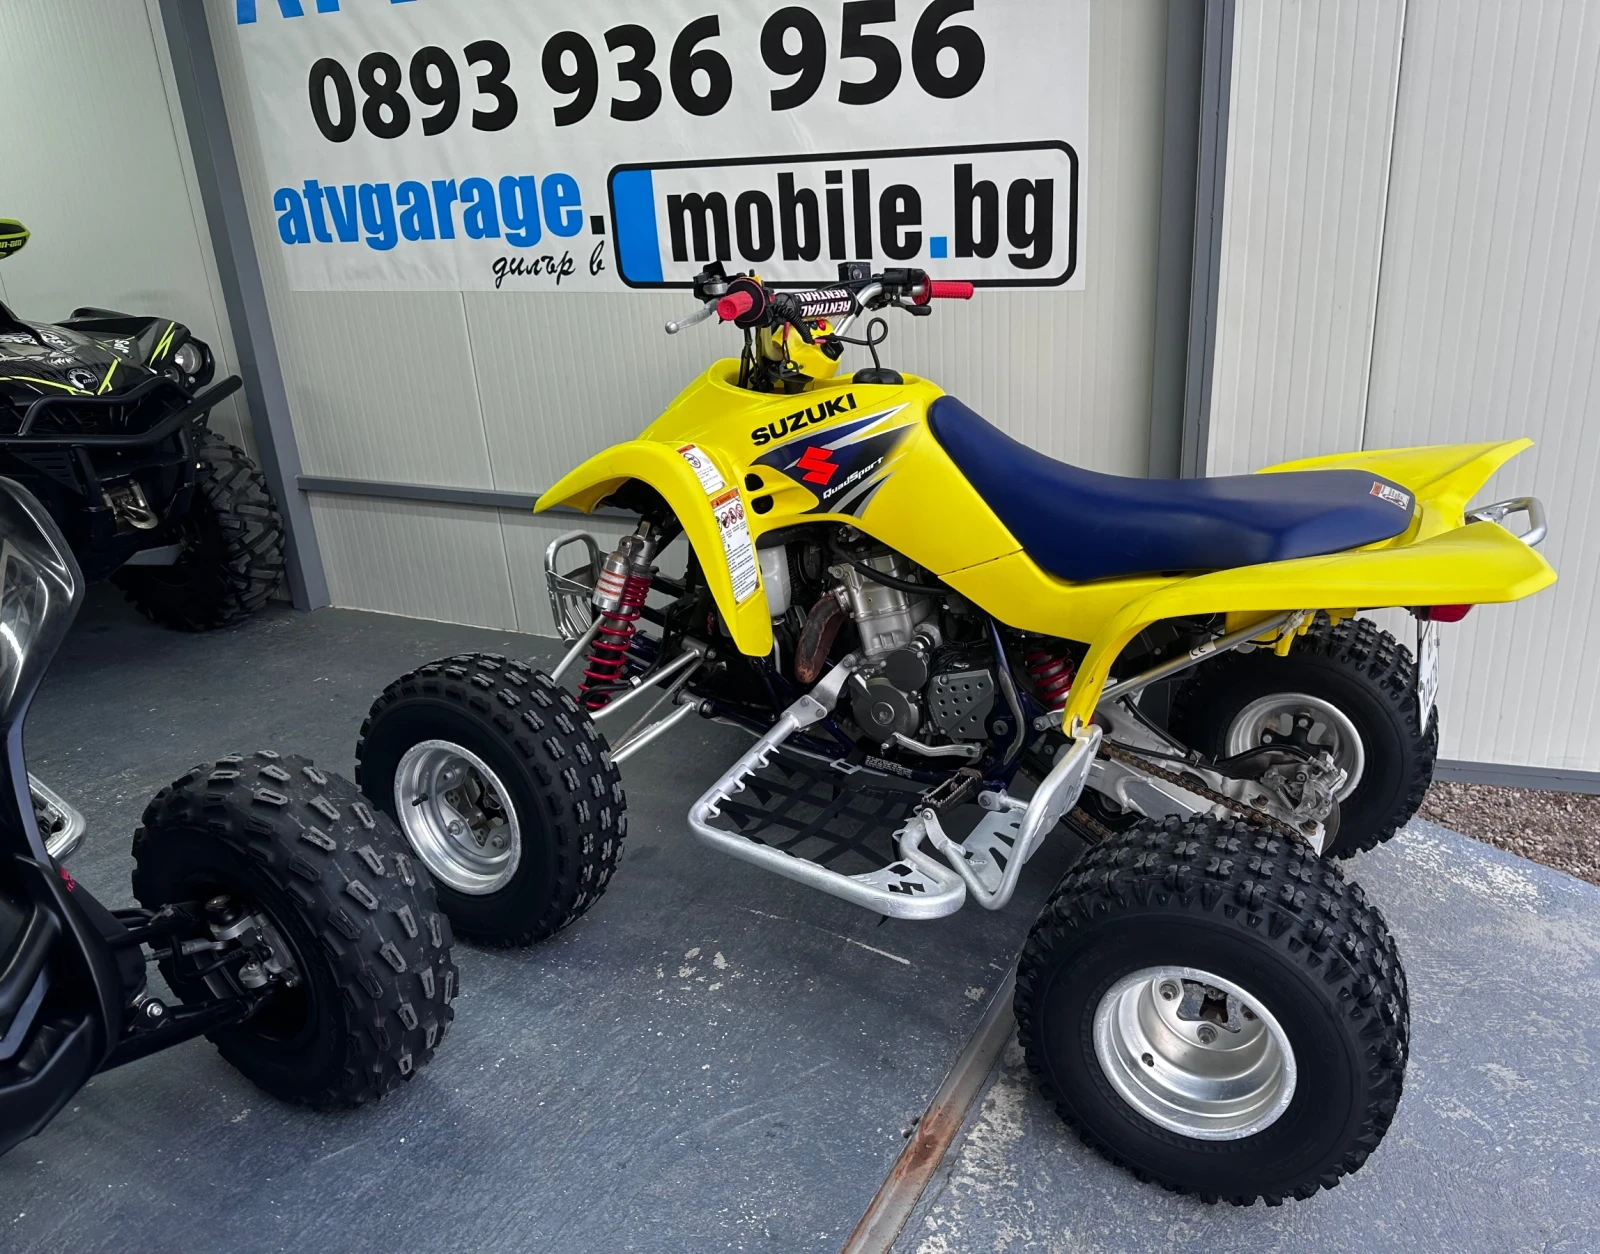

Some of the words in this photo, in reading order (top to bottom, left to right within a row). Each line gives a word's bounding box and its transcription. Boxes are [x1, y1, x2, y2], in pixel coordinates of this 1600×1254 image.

[308, 39, 519, 143] 0893
[541, 14, 733, 127] 936
[759, 0, 986, 112] 956
[666, 162, 1055, 270] mobile.bg
[0, 239, 22, 249] n-am
[795, 288, 849, 303] RENTHAL
[800, 300, 852, 317] RENTHAL
[750, 391, 858, 447] SUZUKI
[822, 455, 885, 500] QuadSport
